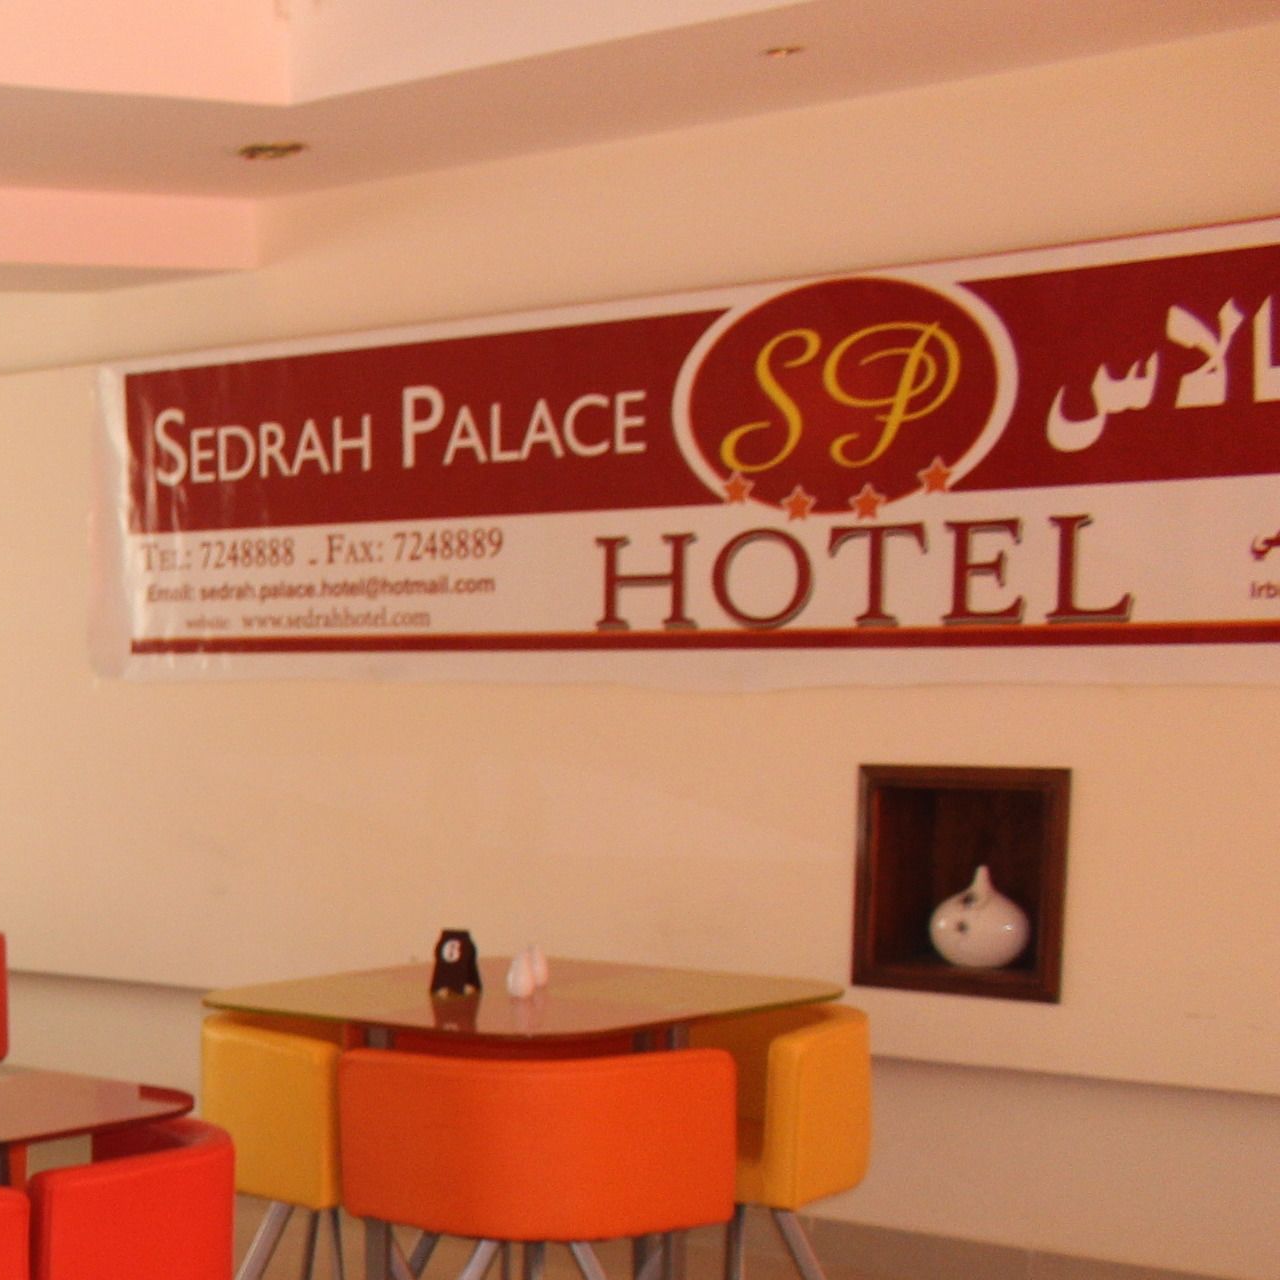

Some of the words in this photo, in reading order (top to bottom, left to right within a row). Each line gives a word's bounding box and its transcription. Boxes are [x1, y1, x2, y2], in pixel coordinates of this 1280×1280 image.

[1046, 294, 1280, 452] الاس
[154, 407, 373, 488] SEDRAH
[402, 384, 647, 469] PALACE
[199, 537, 296, 570] 7248888
[393, 527, 504, 563] 7248889
[594, 512, 1136, 632] HOTEL
